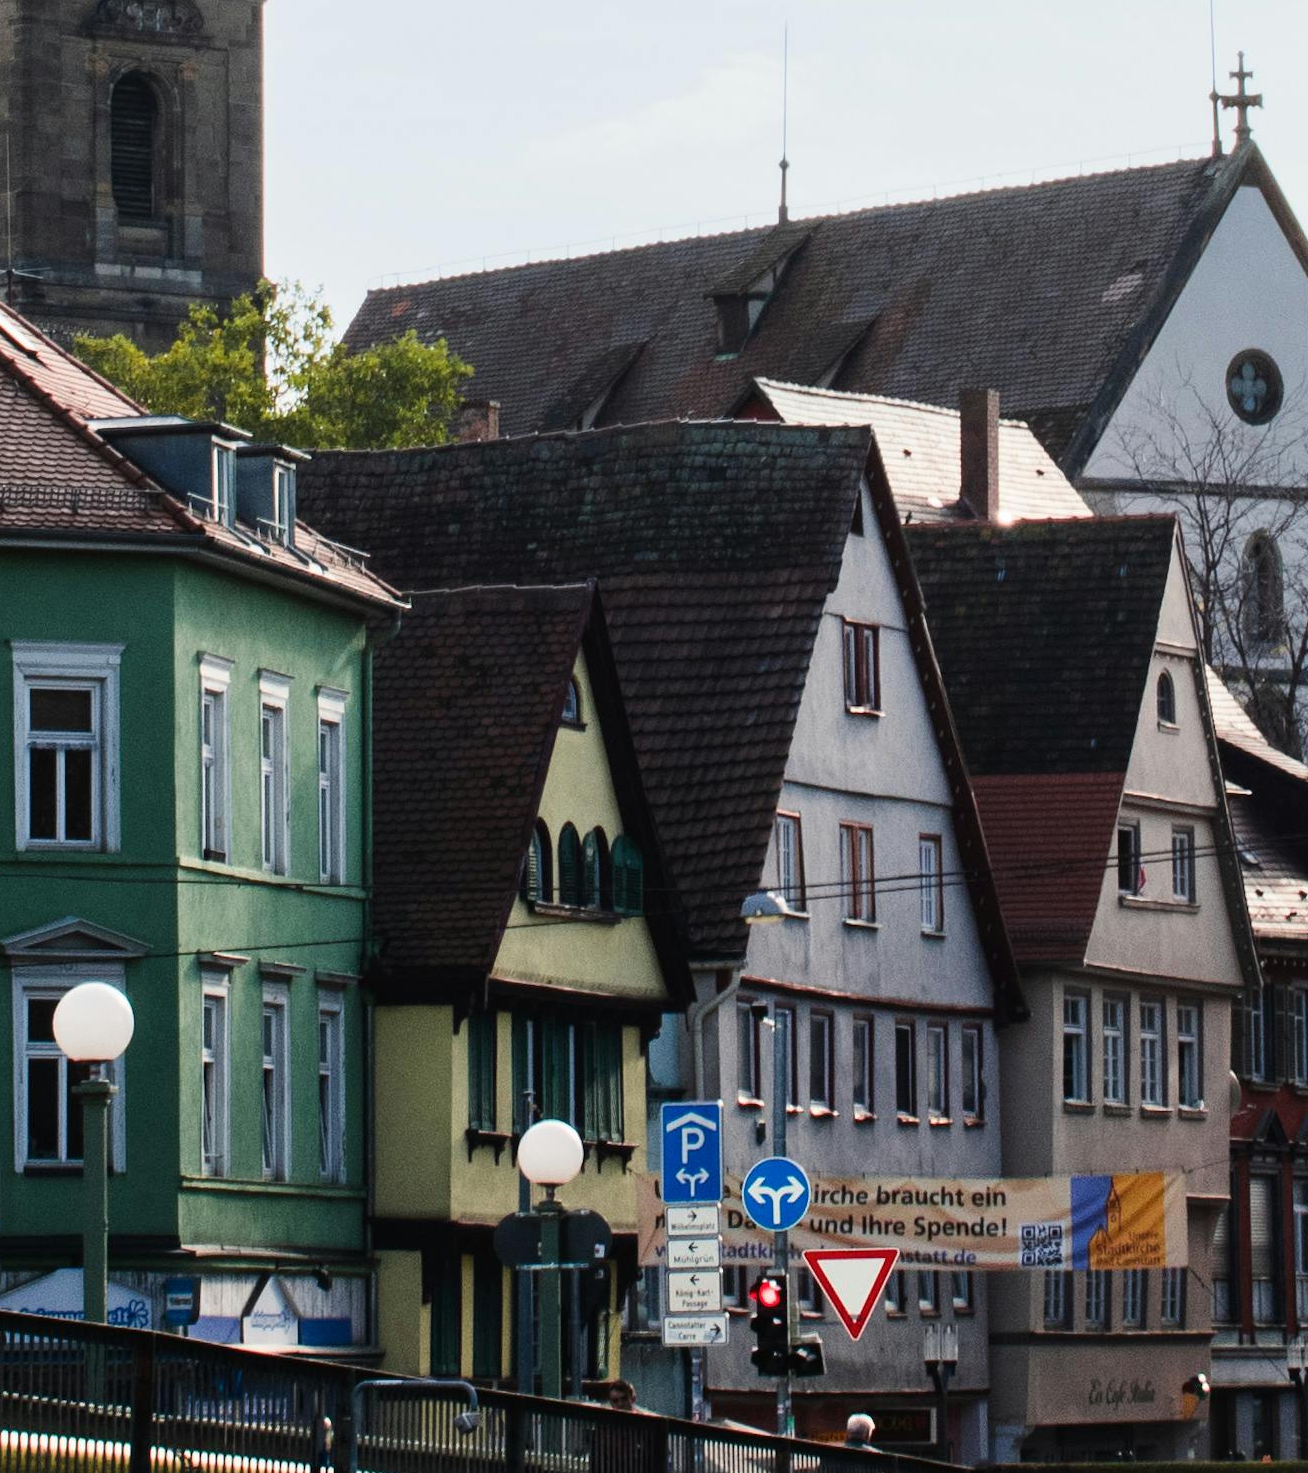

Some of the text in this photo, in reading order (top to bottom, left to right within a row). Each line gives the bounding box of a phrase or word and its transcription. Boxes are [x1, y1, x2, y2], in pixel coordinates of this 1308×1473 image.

[682, 1127, 705, 1164] P
[876, 1185, 965, 1206] braucht
[971, 1187, 1007, 1206] ein
[809, 1215, 853, 1235] und
[861, 1216, 906, 1236] Ihre
[913, 1217, 1008, 1242] Spende!
